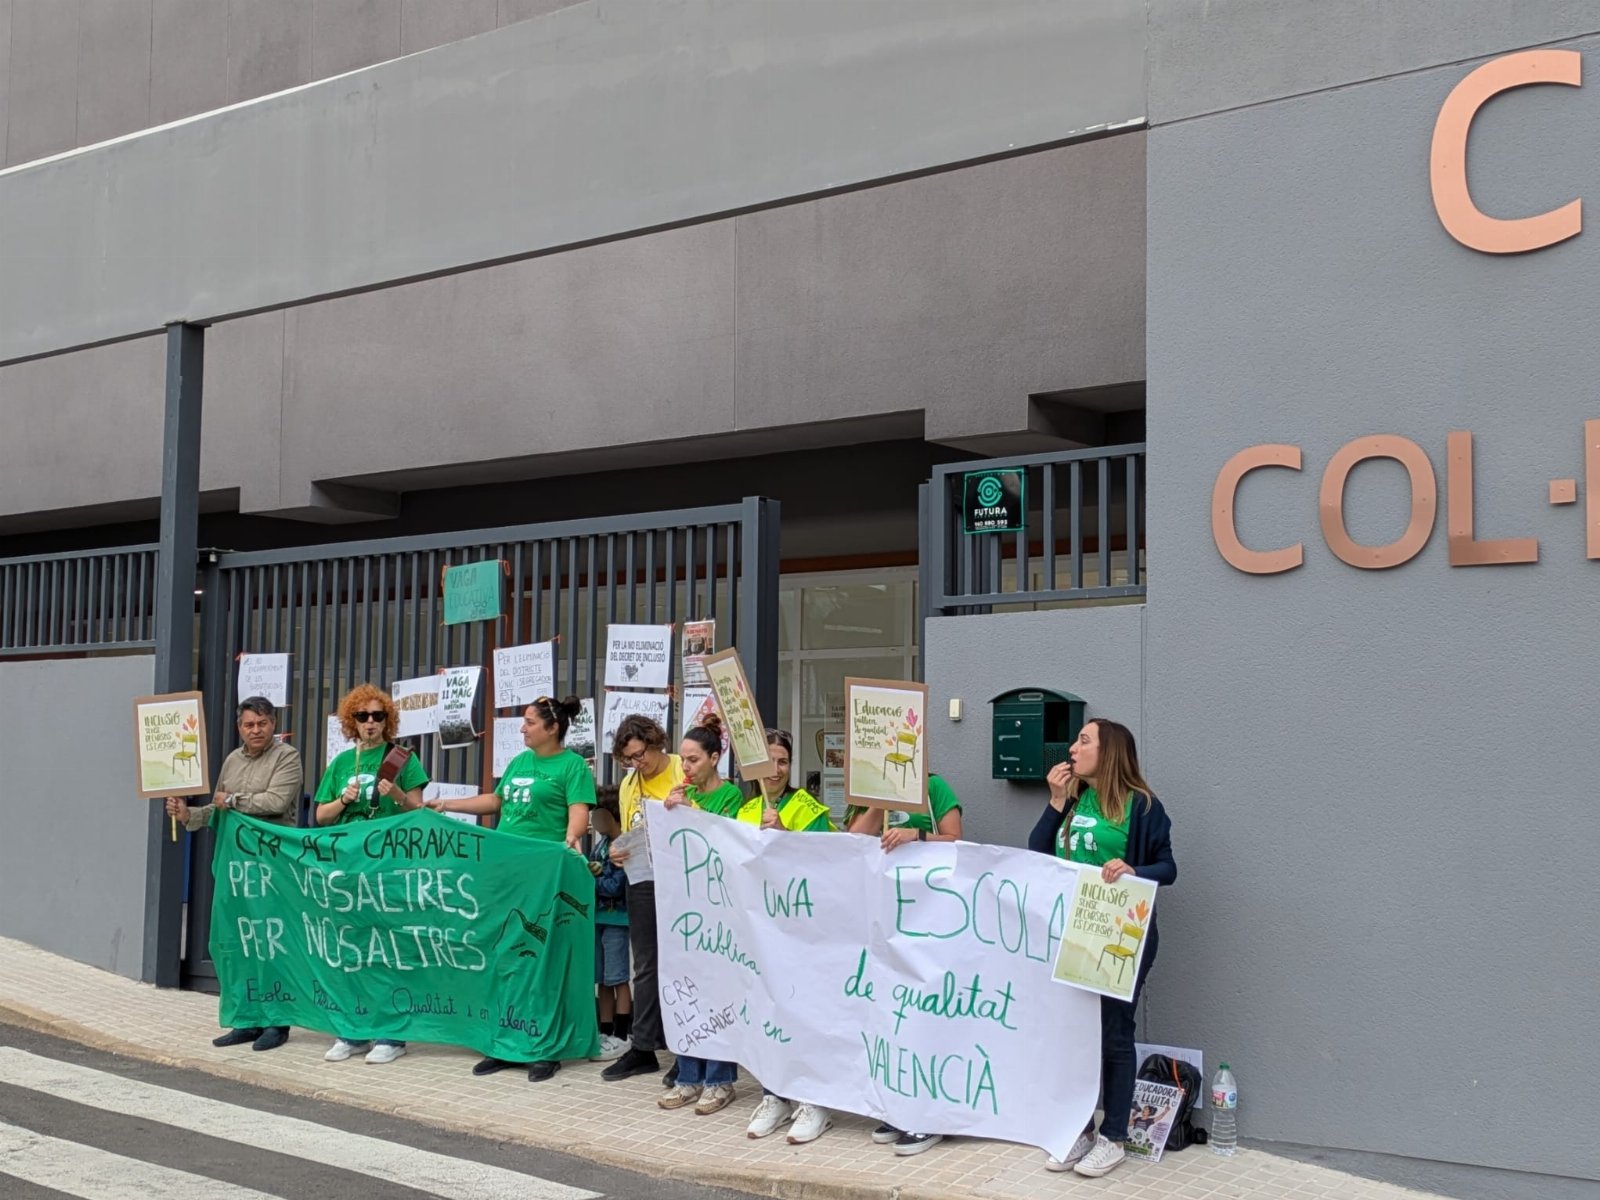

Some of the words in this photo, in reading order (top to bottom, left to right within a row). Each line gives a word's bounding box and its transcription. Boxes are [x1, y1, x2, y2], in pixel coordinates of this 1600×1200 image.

[1430, 48, 1582, 254] C
[1211, 419, 1600, 574] COL·
[974, 507, 1007, 516] FUTURA
[449, 568, 477, 589] VAGA
[612, 640, 620, 649] PER
[621, 640, 627, 649] LA
[628, 641, 635, 650] NO
[636, 638, 664, 650] ELIMINACIÓ
[497, 652, 511, 665] PER
[619, 652, 635, 661] DECRET
[446, 676, 470, 688] VAGA
[500, 668, 510, 676] DEL
[442, 690, 449, 699] 11
[450, 687, 473, 699] MAIG
[144, 710, 181, 728] INCLUSIÓ
[854, 698, 905, 718] Educació
[235, 823, 281, 858] CRA
[296, 832, 348, 864] ALT
[363, 827, 486, 862] CARRAIXET
[228, 860, 279, 899] PER
[288, 862, 480, 920] VOSALTRES
[669, 828, 734, 908] PER
[763, 877, 814, 919] UNA
[896, 865, 1065, 963] ESCOLA
[1080, 881, 1130, 909] INCLUSIÓ
[1073, 906, 1112, 925] RECURSOS
[1078, 897, 1099, 911] SENSE
[237, 915, 288, 961] PER
[301, 911, 487, 973] NOSALTRES
[671, 911, 762, 976] Pública
[845, 948, 877, 1002] de
[891, 970, 1018, 1036] qualitat
[392, 987, 458, 1016] Qualitat
[662, 975, 700, 1007] CRA
[674, 999, 702, 1027] ALT
[676, 1002, 738, 1054] CARRAIXET
[740, 999, 750, 1025] i
[763, 1020, 792, 1043] en
[861, 1030, 999, 1116] VALENCIÀ
[1141, 1094, 1171, 1108] LLUITA
